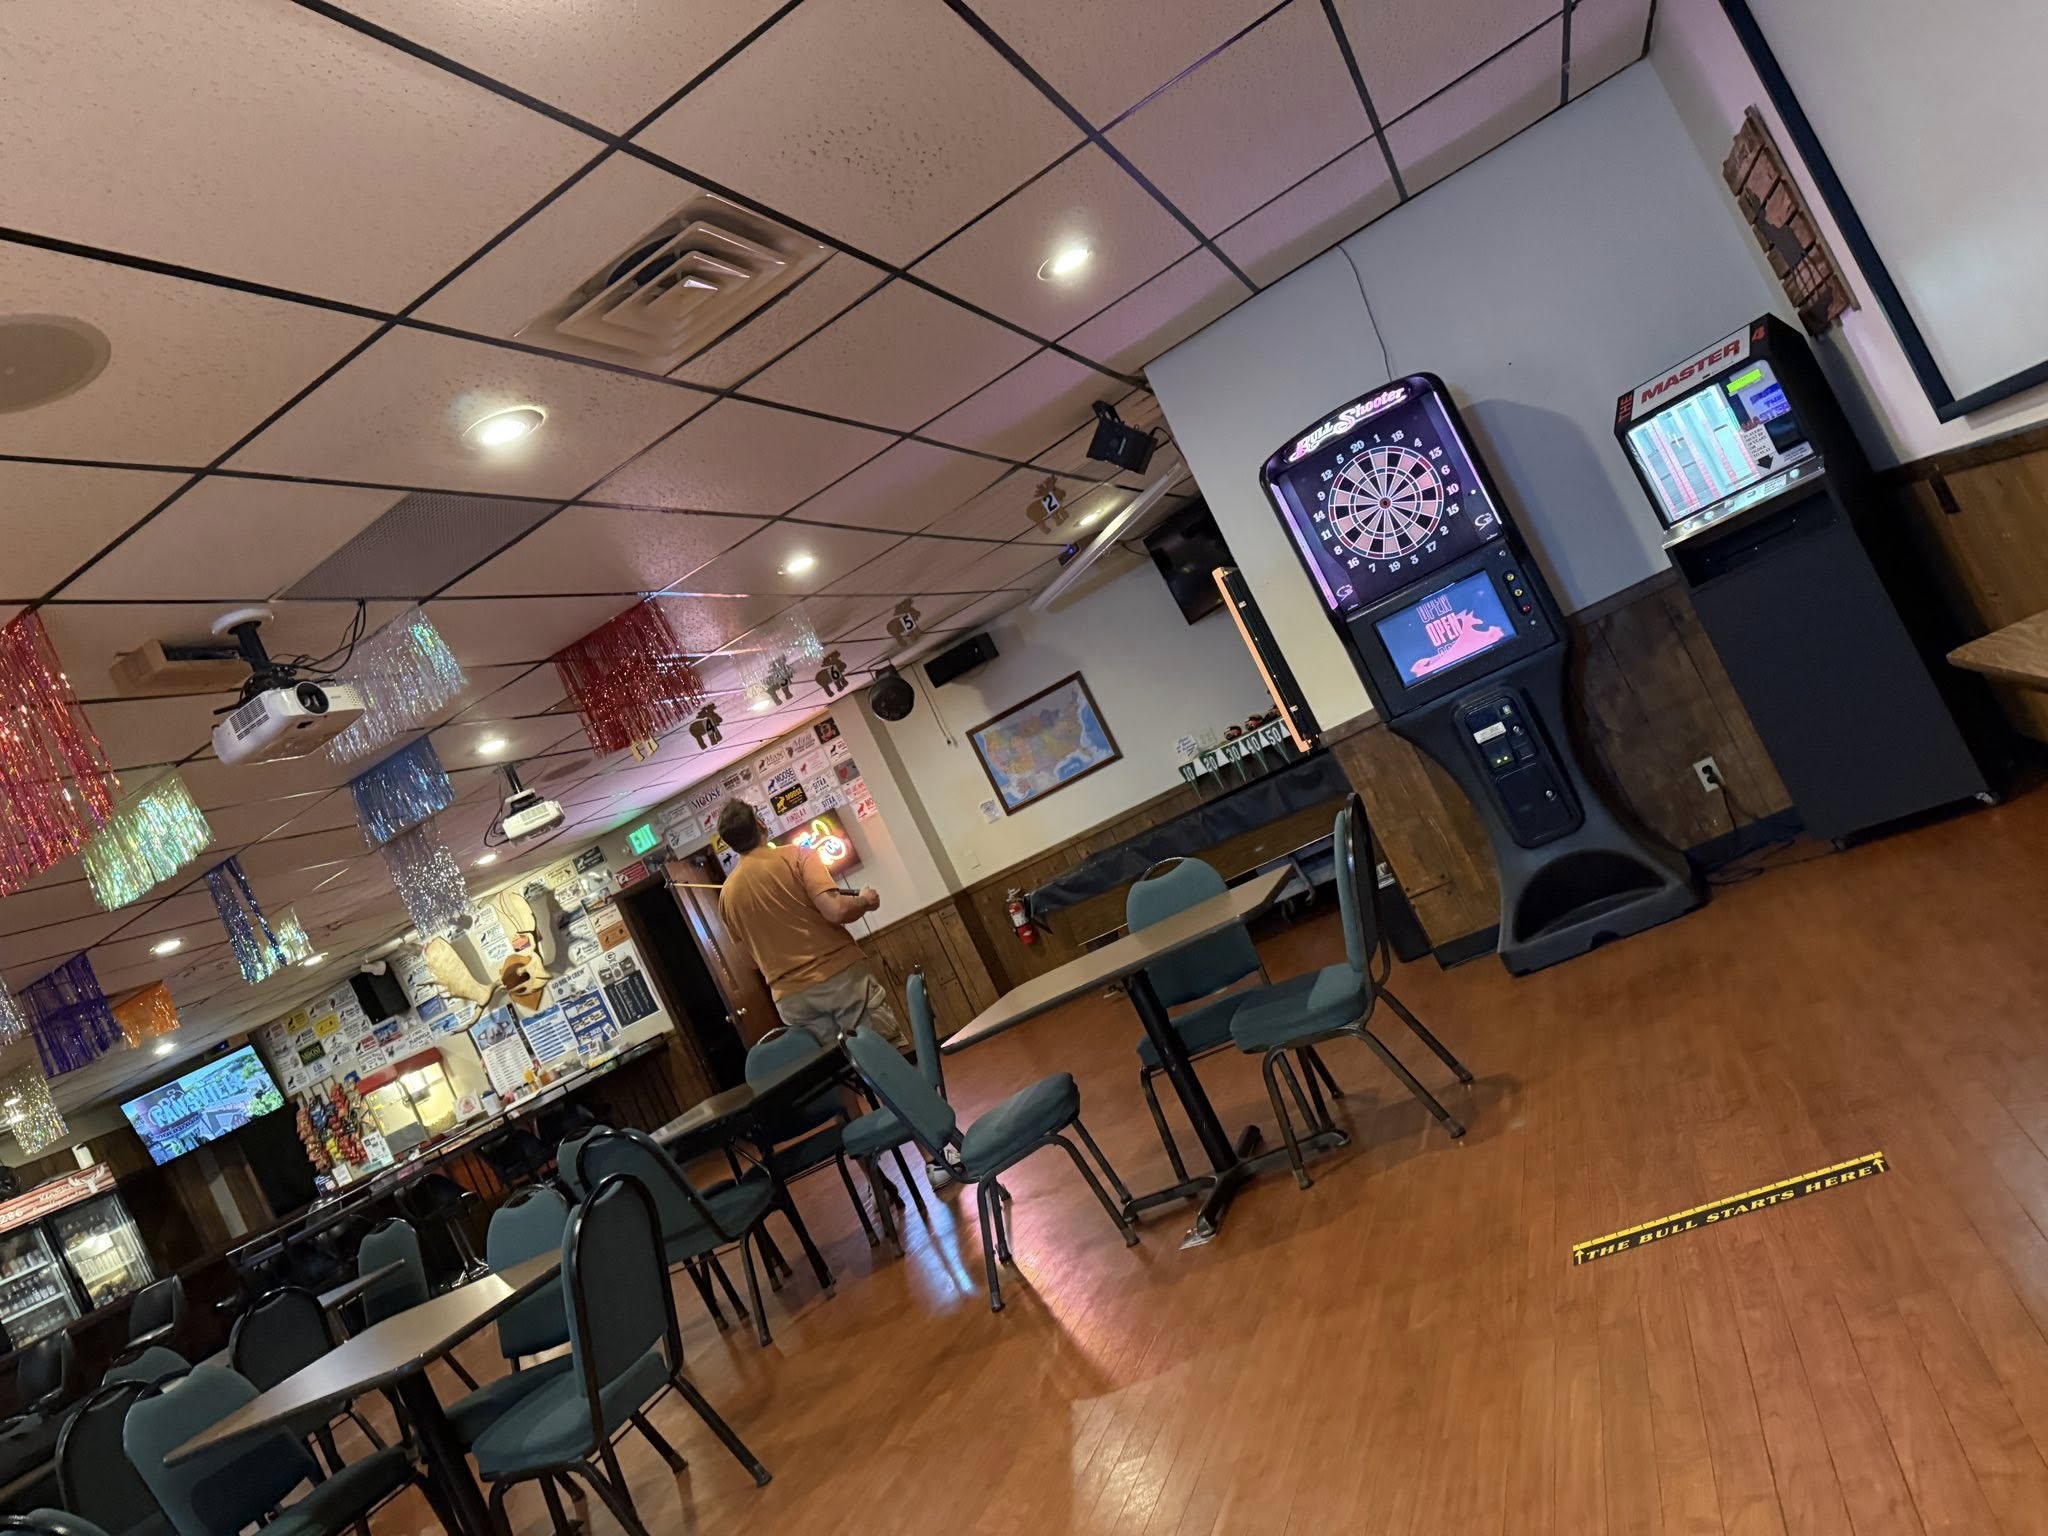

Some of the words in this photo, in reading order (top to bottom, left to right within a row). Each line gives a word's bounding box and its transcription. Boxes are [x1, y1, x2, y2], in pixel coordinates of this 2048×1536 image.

[1752, 326, 1766, 342] 4
[1641, 340, 1740, 404] MASTER
[1333, 387, 1407, 434] Shooter
[1617, 394, 1633, 423] THE
[1373, 433, 1381, 443] 1
[1391, 430, 1404, 443] 18
[1414, 437, 1423, 448] 4
[1350, 440, 1365, 454] 20
[1428, 446, 1443, 460] 13
[1336, 453, 1345, 465] 5
[1321, 469, 1334, 482] 12
[1441, 464, 1451, 475] 6
[1317, 491, 1326, 501] 9
[1446, 483, 1459, 496] 10
[1043, 495, 1058, 512] 2
[1446, 503, 1460, 517] 15
[1313, 510, 1326, 523] 14
[1321, 528, 1333, 541] 11
[1440, 525, 1449, 536] 2
[1333, 545, 1343, 556] 8
[1425, 540, 1437, 554] 17
[1347, 557, 1360, 569] 16
[1410, 554, 1419, 565] 3
[1368, 562, 1376, 573] 7
[1388, 561, 1401, 573] 19
[903, 614, 914, 630] 5
[1425, 613, 1463, 648] OPEN
[831, 667, 840, 680] 6
[705, 720, 716, 734] 4
[1183, 766, 1196, 782] 10
[1203, 755, 1218, 772] 20
[1226, 745, 1241, 763] 30
[1246, 736, 1261, 754] 40
[1265, 727, 1282, 746] 50
[774, 768, 794, 784] MOOSE
[812, 777, 827, 790] SITKA
[1585, 1239, 1630, 1261] THE
[1639, 1219, 1698, 1243] BULL
[1706, 1189, 1795, 1224] STARTS
[1805, 1166, 1872, 1193] HERE
